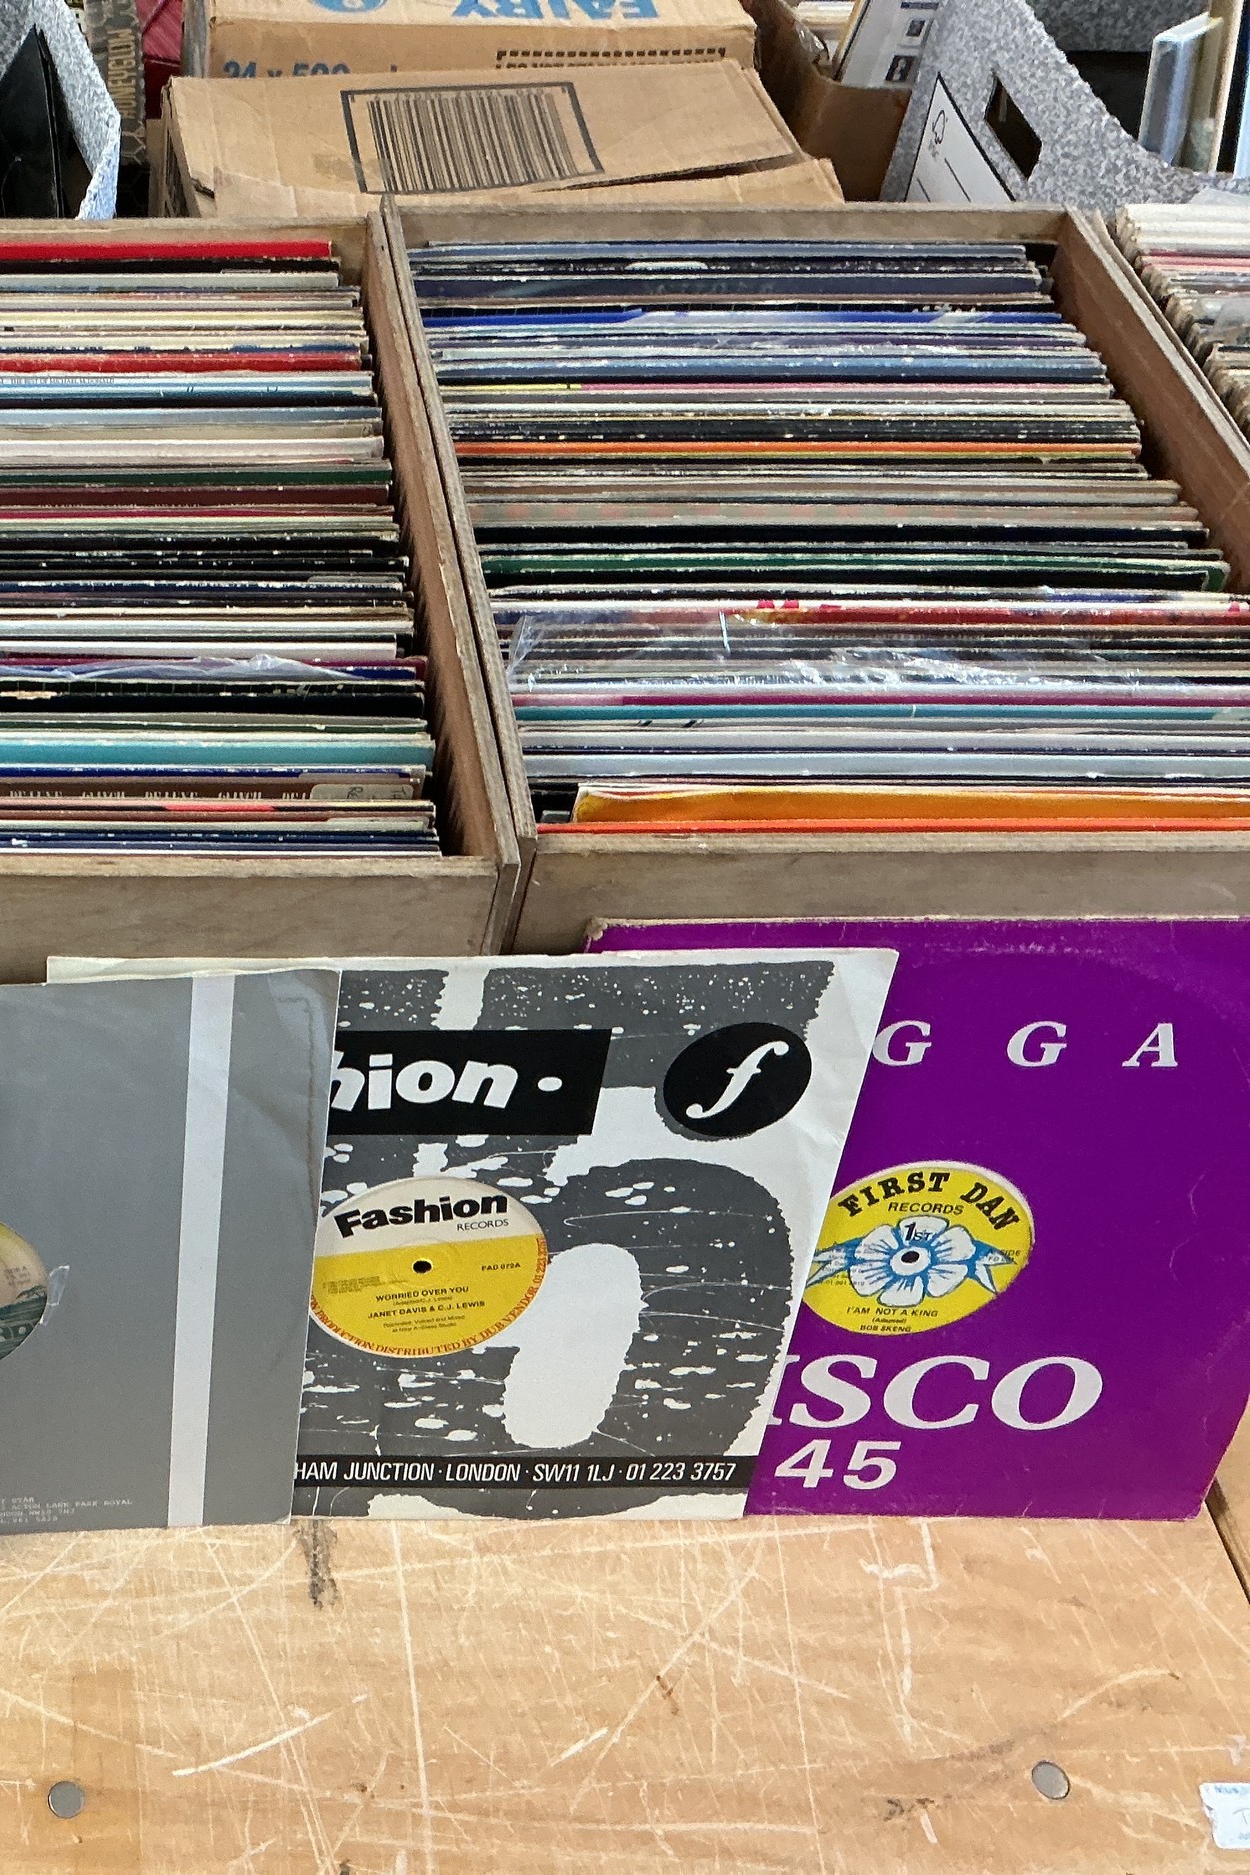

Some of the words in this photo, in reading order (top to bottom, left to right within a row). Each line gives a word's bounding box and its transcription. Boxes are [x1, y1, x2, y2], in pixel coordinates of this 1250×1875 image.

[332, 1053, 520, 1112] hion
[838, 1171, 950, 1218] FIRST
[960, 1182, 1021, 1231] DAN
[888, 1202, 964, 1215] RECORDS
[334, 1195, 508, 1238] Fashion
[456, 1219, 510, 1232] RECORDS
[376, 1290, 419, 1302] WORRIED
[421, 1288, 447, 1297] OVER
[449, 1286, 469, 1294] YOU
[368, 1309, 396, 1319] JANET
[399, 1306, 427, 1315] DAVIS
[456, 1300, 485, 1309] LEWIS
[876, 1307, 897, 1316] NOT
[900, 1308, 908, 1316] A
[911, 1309, 939, 1318] KING
[295, 1462, 337, 1481] HAM
[343, 1463, 435, 1481] JUNCTION
[446, 1463, 521, 1481] LONDON
[532, 1463, 580, 1481] SW11
[587, 1463, 613, 1482] 1LJ
[626, 1463, 647, 1481] 01
[650, 1462, 684, 1481] 223
[690, 1462, 736, 1481] 3757
[774, 1439, 901, 1490] 45
